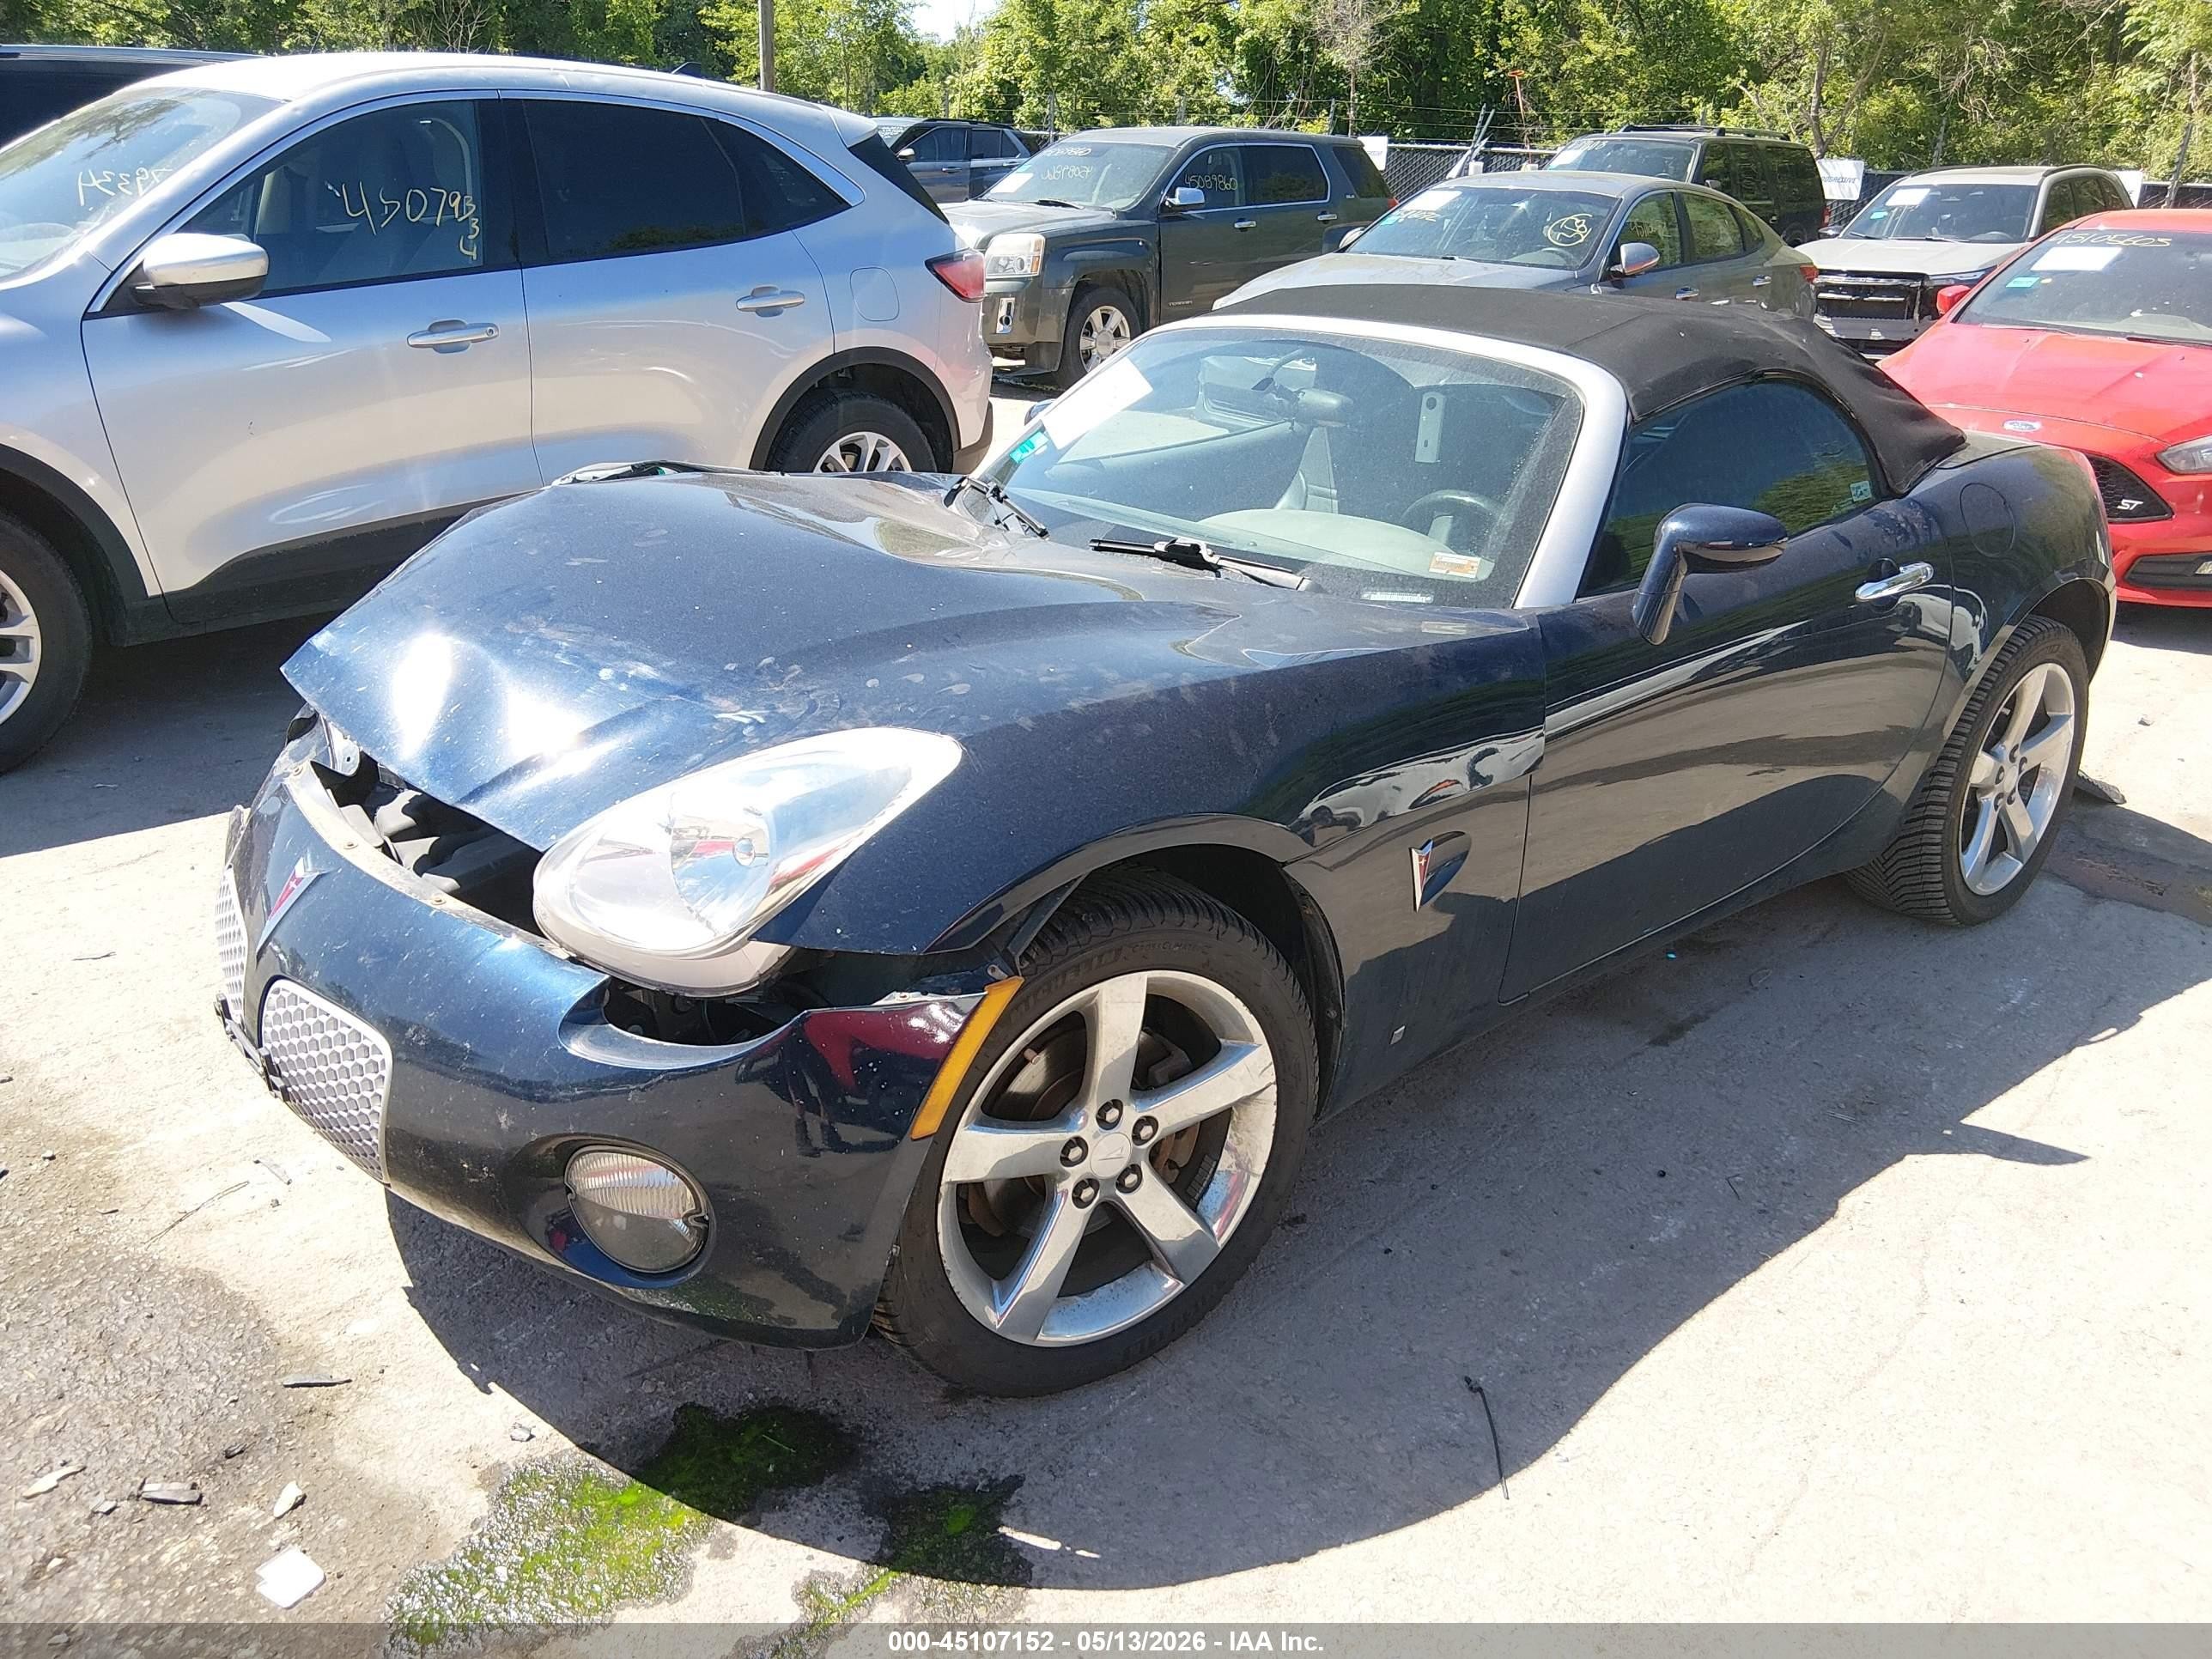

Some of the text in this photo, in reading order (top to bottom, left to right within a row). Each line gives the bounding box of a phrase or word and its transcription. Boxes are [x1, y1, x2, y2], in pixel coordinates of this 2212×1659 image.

[1184, 173, 1238, 191] 45089860
[2049, 233, 2172, 247] 45105605
[2117, 499, 2143, 511] ST
